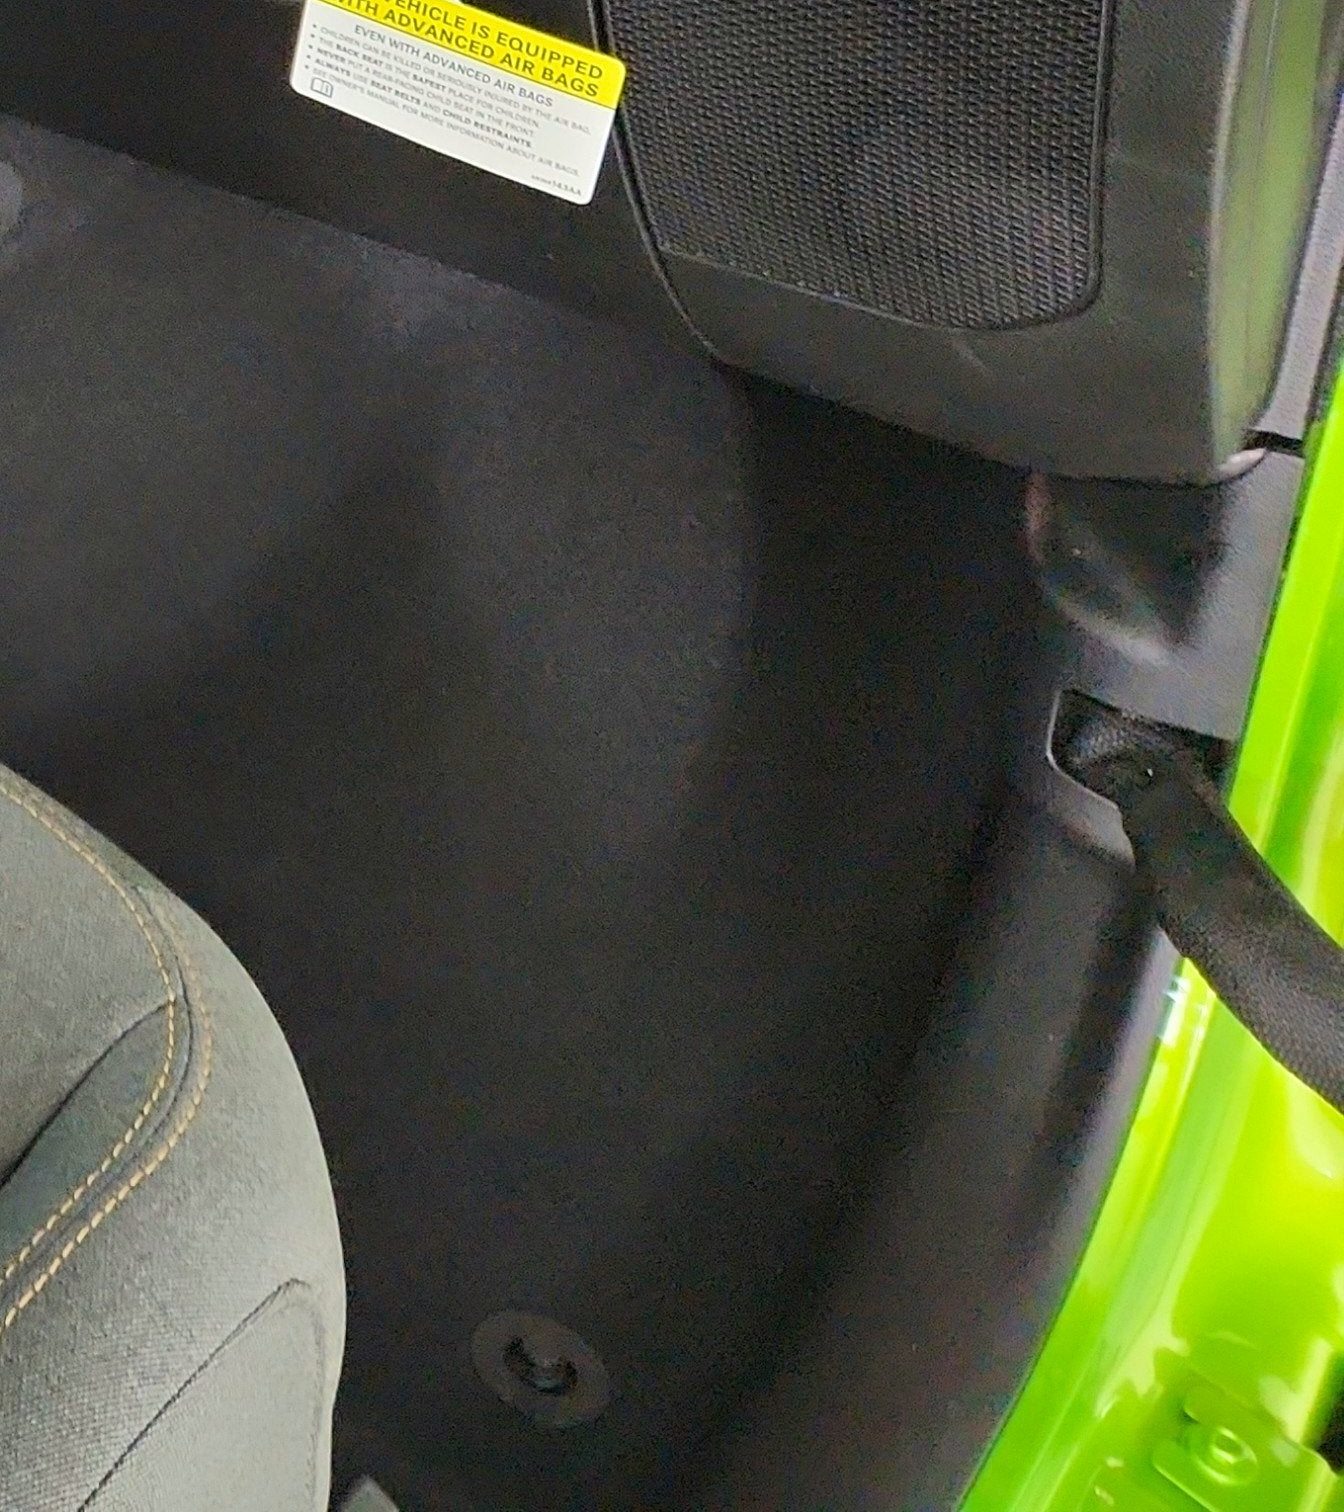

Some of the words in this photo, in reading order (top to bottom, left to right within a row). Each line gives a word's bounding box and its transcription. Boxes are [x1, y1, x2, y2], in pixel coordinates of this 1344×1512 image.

[353, 24, 386, 44] EVEN
[387, 37, 420, 57] WITH
[422, 50, 491, 85] ADVANCED
[493, 76, 516, 94] AIR
[518, 86, 553, 108] BAGS
[383, 7, 495, 60] ADVANCED
[499, 50, 536, 75] AIR
[541, 64, 600, 98] BAGS
[470, 21, 491, 40] IS
[495, 30, 604, 82] EQUIPPED
